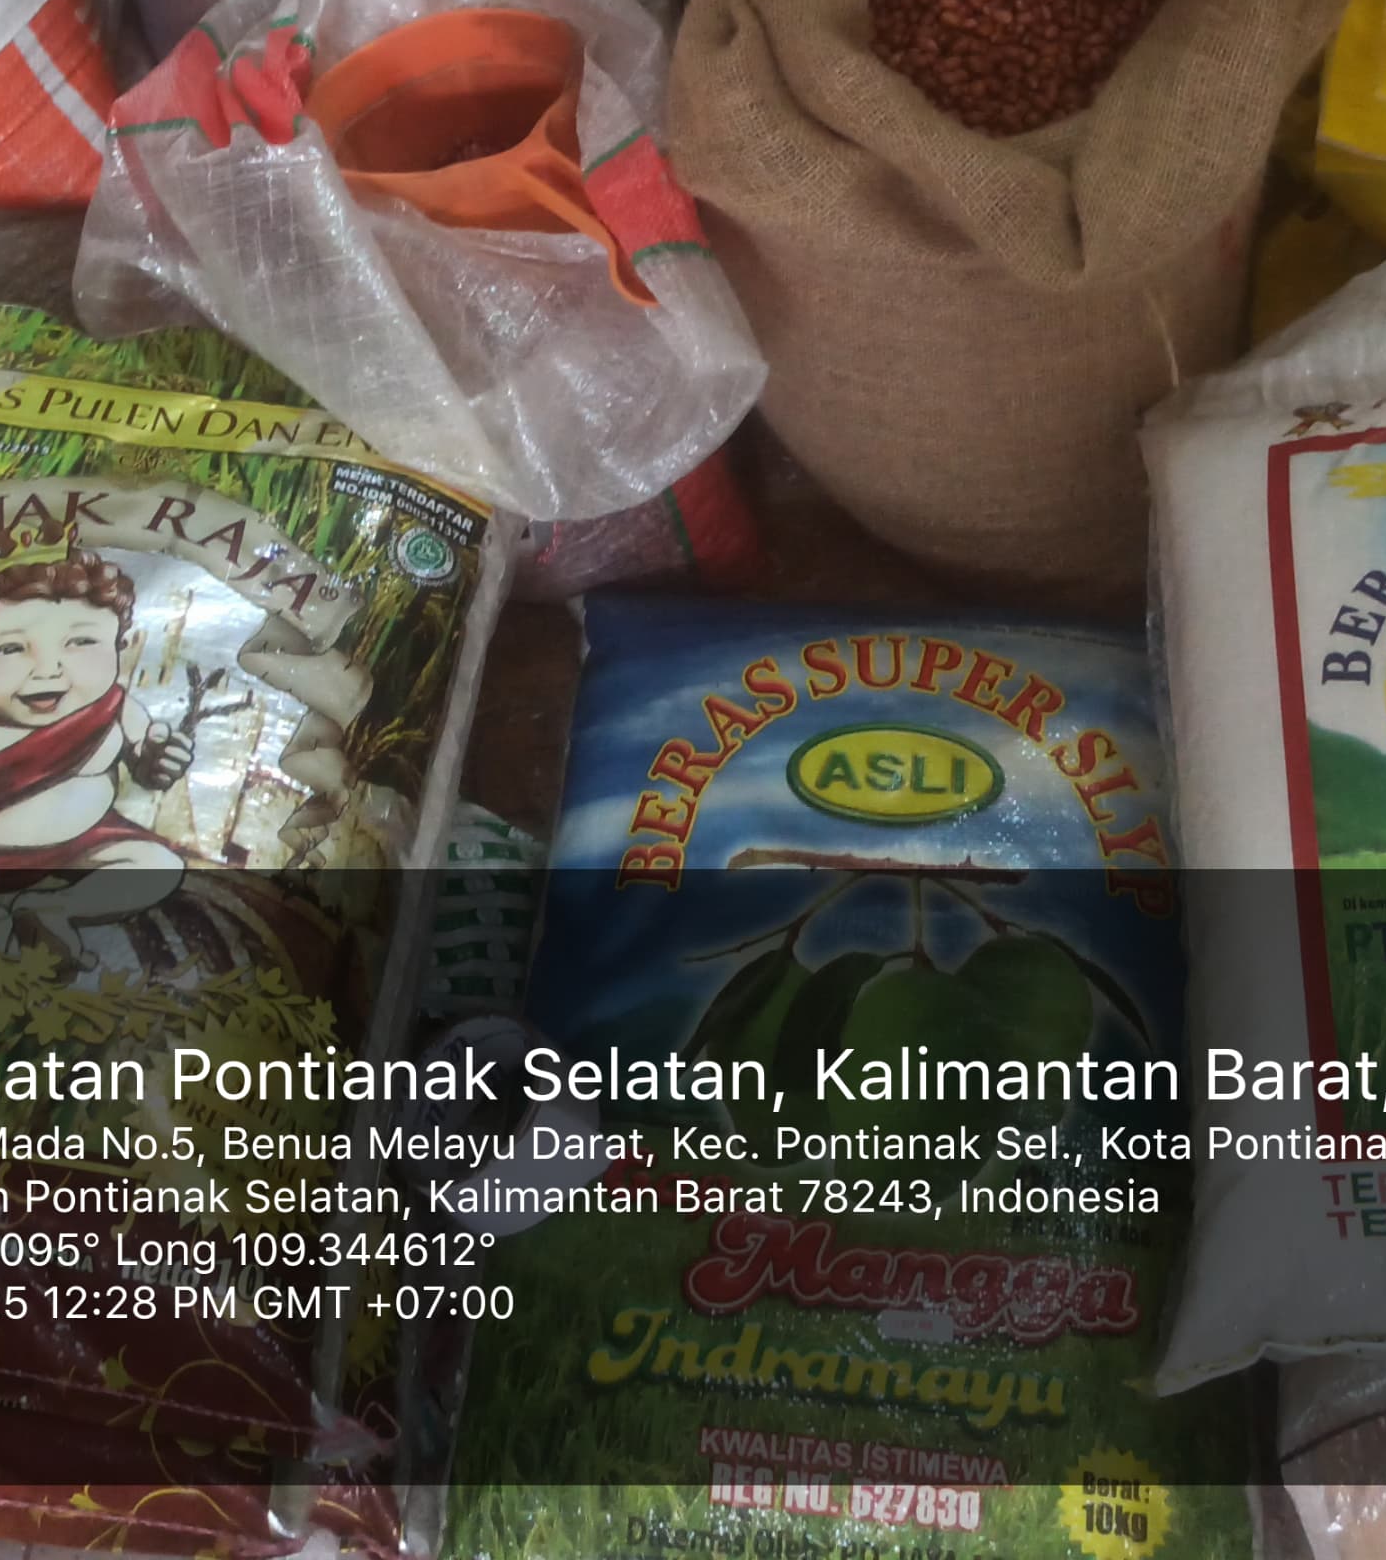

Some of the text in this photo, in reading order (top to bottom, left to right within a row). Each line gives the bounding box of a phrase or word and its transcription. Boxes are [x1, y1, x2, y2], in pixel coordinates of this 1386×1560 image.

[37, 386, 186, 435] PULEN
[196, 407, 303, 446] DAN
[146, 493, 324, 621] RAJA
[616, 633, 1178, 921] BERAS SUPER SLYP
[814, 750, 967, 796] ASLI
[685, 1211, 1144, 1343] Mangga
[587, 1306, 1066, 1429] Indramayu
[699, 1427, 1009, 1486] KWALITAS ISTIMEWA
[711, 1463, 774, 1506] REG
[1081, 1500, 1149, 1543] 10kg
